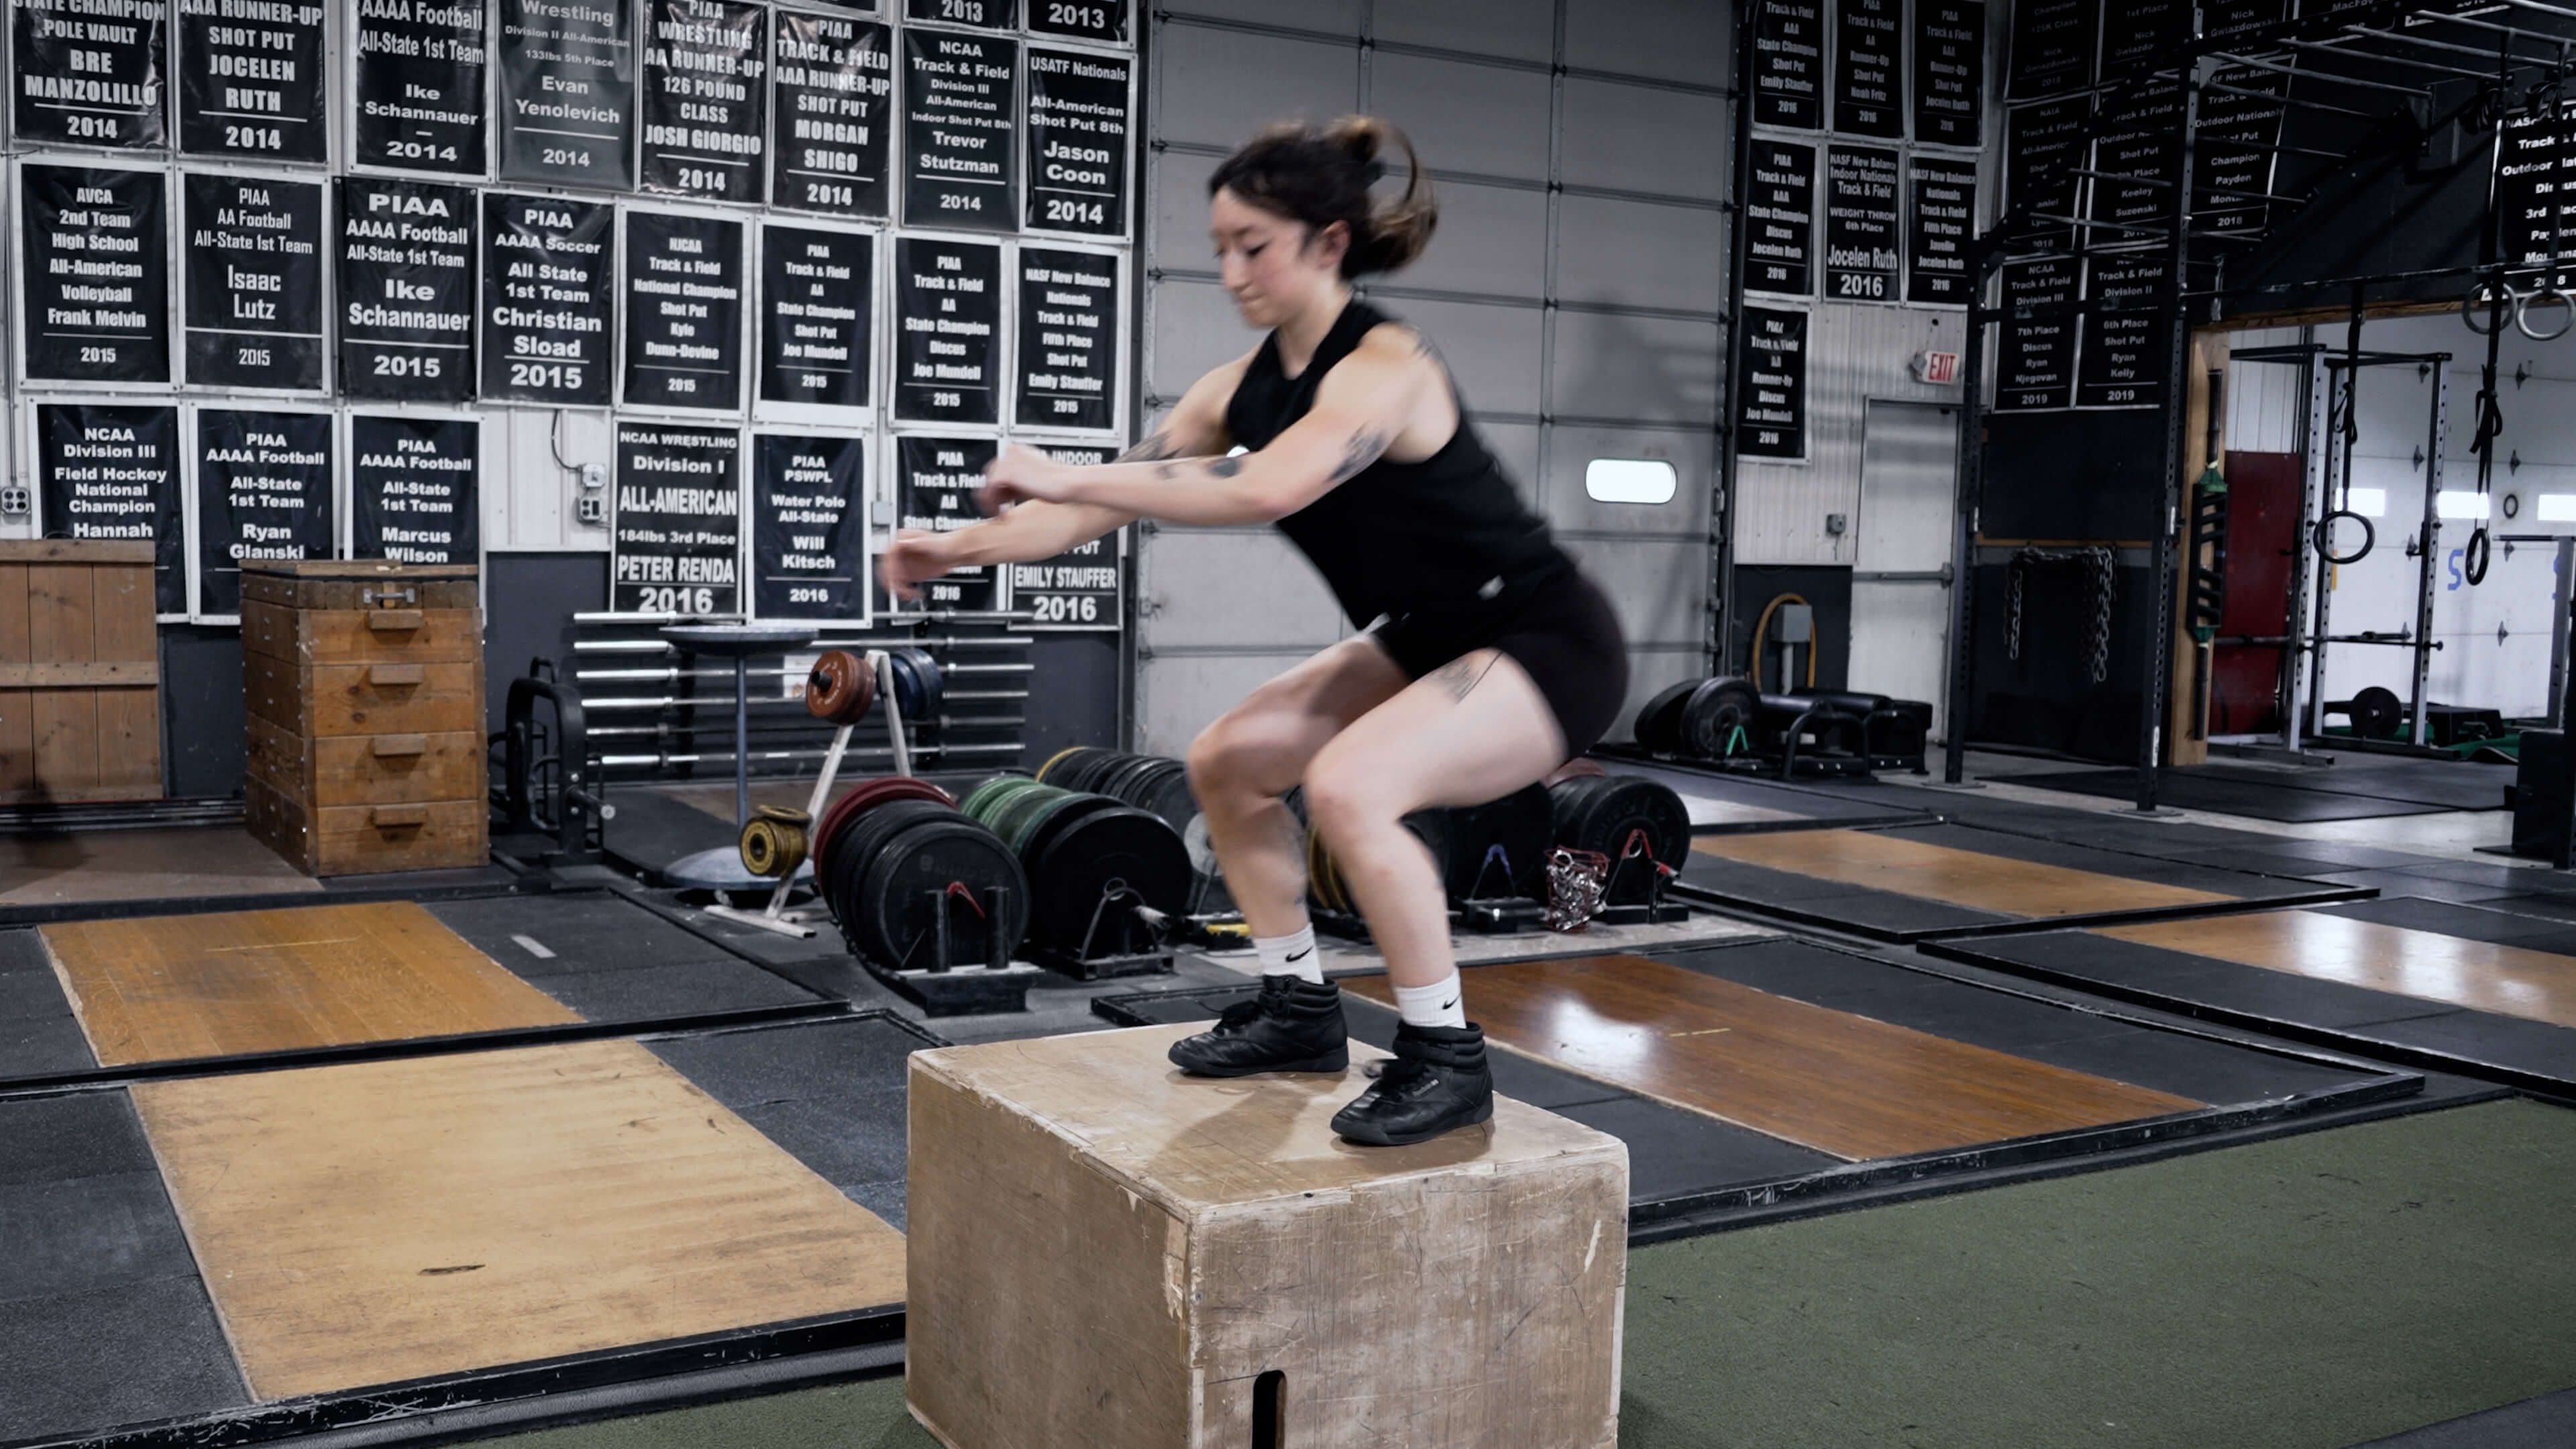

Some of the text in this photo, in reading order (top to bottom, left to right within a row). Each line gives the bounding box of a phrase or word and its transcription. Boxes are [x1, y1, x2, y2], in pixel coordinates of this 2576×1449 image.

[69, 0, 165, 21] CHAMPION
[689, 0, 723, 19] PIAA
[942, 0, 982, 22] 2013
[1049, 3, 1104, 28] 2013
[43, 18, 137, 44] POLE VAULT
[505, 25, 548, 38] Division
[562, 32, 630, 48] All-American
[659, 21, 752, 50] WRESTLING
[526, 49, 615, 68] 133lbs 5th Place
[940, 41, 982, 56] NCAA
[70, 50, 112, 73] BRE
[644, 48, 764, 78] AA RUNNER-UP
[913, 57, 1009, 79] Track & Field
[1030, 57, 1126, 80] USATF Nationals
[25, 74, 157, 106] MANZOLILLO
[406, 84, 440, 100] Ike
[543, 76, 588, 95] Evan
[663, 76, 745, 101] 126 POUND
[931, 78, 989, 94] Division III
[365, 101, 478, 125] Schannauer
[516, 99, 620, 123] Yenolevich
[681, 103, 728, 123] CLASS
[926, 95, 997, 111] All-American
[1030, 96, 1124, 117] All-American
[68, 116, 117, 138] 2014
[912, 112, 1012, 130] Indoor Shot Put 8th
[1030, 113, 1123, 134] Shot Put 8th
[645, 125, 761, 154] JOSH GIORGIO
[932, 131, 986, 148] Trevor
[2518, 136, 2555, 149] Track
[386, 142, 457, 161] 2014
[543, 149, 590, 166] 2014
[1044, 141, 1109, 163] Jason
[920, 154, 998, 173] Stutzman
[1046, 164, 1106, 184] Coon
[679, 168, 725, 191] 2014
[239, 188, 270, 205] PIAA
[369, 194, 449, 217] PIAA
[941, 195, 981, 210] 2014
[217, 209, 291, 229] AA Football
[525, 209, 573, 228] PIAA
[1047, 200, 1103, 224] 2014
[2526, 207, 2546, 219] 3rd
[195, 230, 252, 249] All-State
[278, 236, 313, 254] Team
[346, 219, 468, 244] AAAA Football
[495, 233, 601, 254] AAAA Soccer
[347, 244, 464, 267] All-State 1st Team
[228, 265, 280, 291] Isaac
[508, 262, 587, 282] All State
[386, 279, 435, 301] Ike
[506, 282, 589, 303] 1st Team
[234, 294, 275, 319] Lutz
[349, 303, 470, 330] Schannauer
[493, 307, 601, 331] Christian
[514, 335, 580, 357] Sload
[239, 349, 270, 366] 2015
[374, 356, 440, 377] 2015
[1929, 354, 1955, 382] EXIT
[511, 364, 582, 388] 2015
[85, 428, 135, 441] NCAA
[620, 431, 737, 448] NCAA WRESTLING
[64, 444, 156, 459] Division III
[792, 455, 825, 468] PIAA
[633, 455, 710, 473] Division
[55, 468, 166, 483] Field Hockey
[785, 470, 833, 483] PSWPL
[76, 483, 148, 496] National
[69, 500, 155, 515] Champion
[620, 486, 737, 515] ALL-AMERICAN
[771, 494, 845, 507] Water Polo
[779, 511, 838, 523] All-State
[74, 523, 153, 537] Hannah
[619, 529, 735, 545] 184lbs 3rd Place
[793, 536, 824, 549] Will
[618, 555, 735, 582] PETER RENDA
[782, 555, 835, 569] Kitsch
[1015, 566, 1116, 588] EMILY STAUFFER
[638, 588, 713, 614] 2016
[790, 588, 828, 602] 2016
[1033, 596, 1096, 621] 2016
